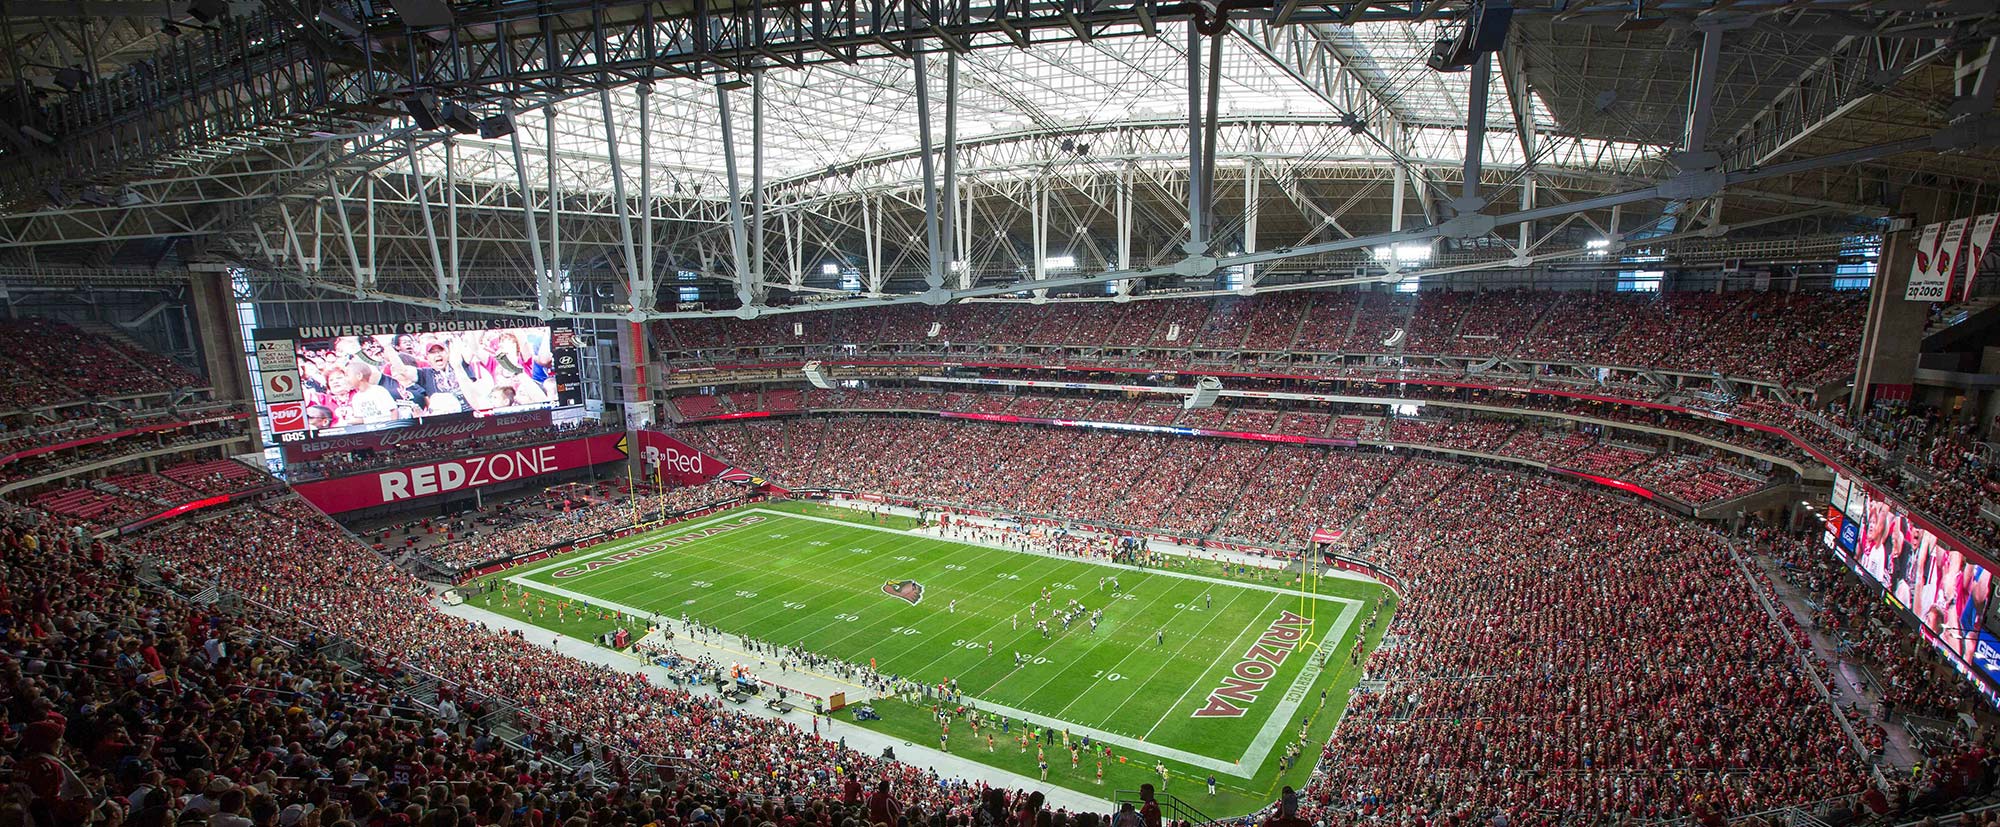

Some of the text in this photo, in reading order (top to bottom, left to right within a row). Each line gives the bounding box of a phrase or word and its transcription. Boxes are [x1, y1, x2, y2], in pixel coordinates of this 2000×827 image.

[1919, 286, 1943, 297] 2008
[299, 318, 546, 338] UNIVERSITY OF PHOENIX STADIUM
[271, 409, 298, 419] CDW
[497, 412, 541, 426] REDZONE
[281, 431, 306, 442] 10:05
[378, 421, 486, 446] Budweiser
[302, 437, 365, 453] REDZONE
[666, 448, 703, 474] Red
[379, 445, 558, 502] REDZONE
[552, 516, 767, 579] CARDINALS
[834, 613, 860, 622] 50
[951, 639, 979, 650] 30
[1191, 610, 1315, 718] ARIZONA
[1091, 670, 1121, 681] 10
[1286, 671, 1315, 703] SERVICE
[393, 770, 410, 785] 58
